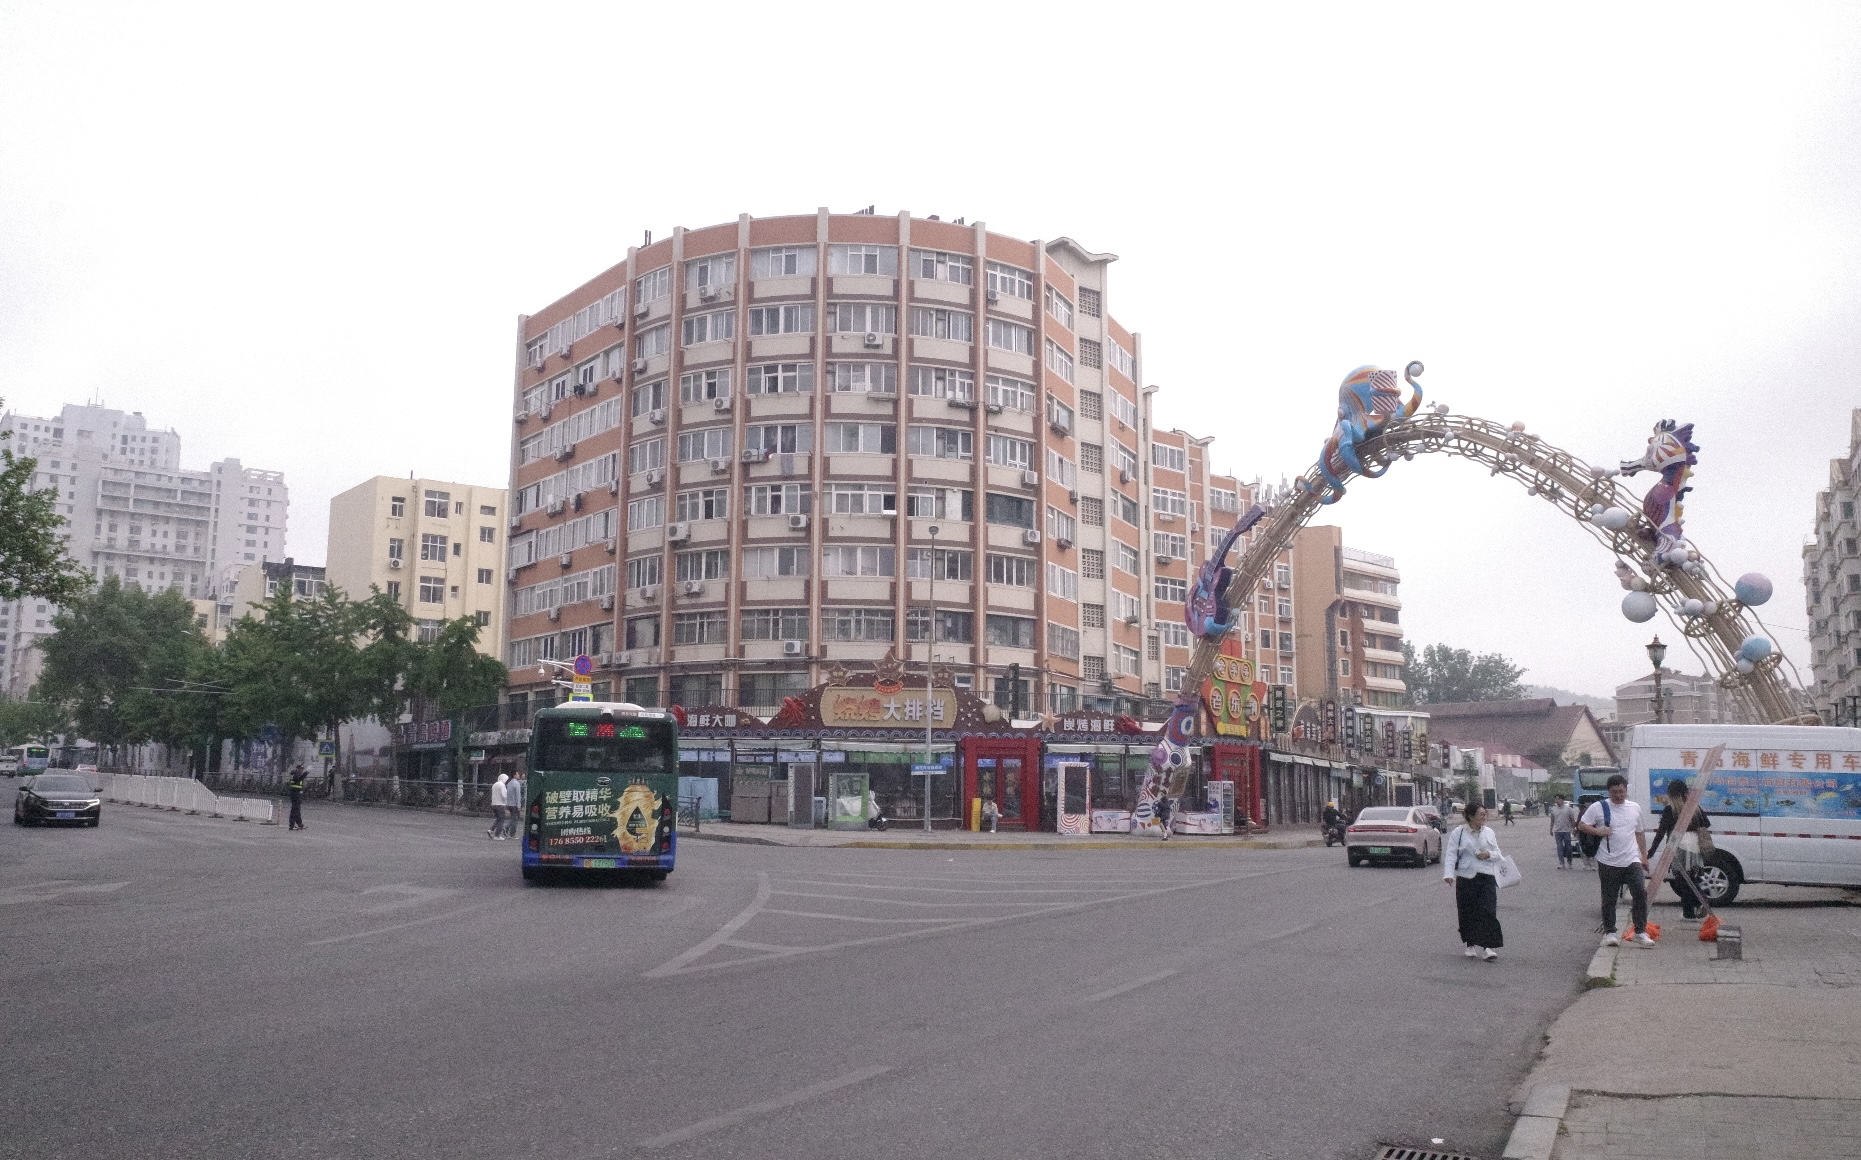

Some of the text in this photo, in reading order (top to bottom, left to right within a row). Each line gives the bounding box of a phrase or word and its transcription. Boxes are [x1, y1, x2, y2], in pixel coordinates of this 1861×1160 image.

[833, 694, 945, 721] 烧烤大排档
[687, 714, 737, 728] 海鲜大咖
[1063, 718, 1115, 732] 炭烤海鲜
[1680, 750, 1861, 772] 青海鲜专用车
[545, 787, 612, 804] 破壁取精华
[545, 803, 611, 820] 营养易吸收
[560, 827, 592, 836] 团购热线
[549, 838, 563, 846] 176
[564, 836, 584, 845] 8550
